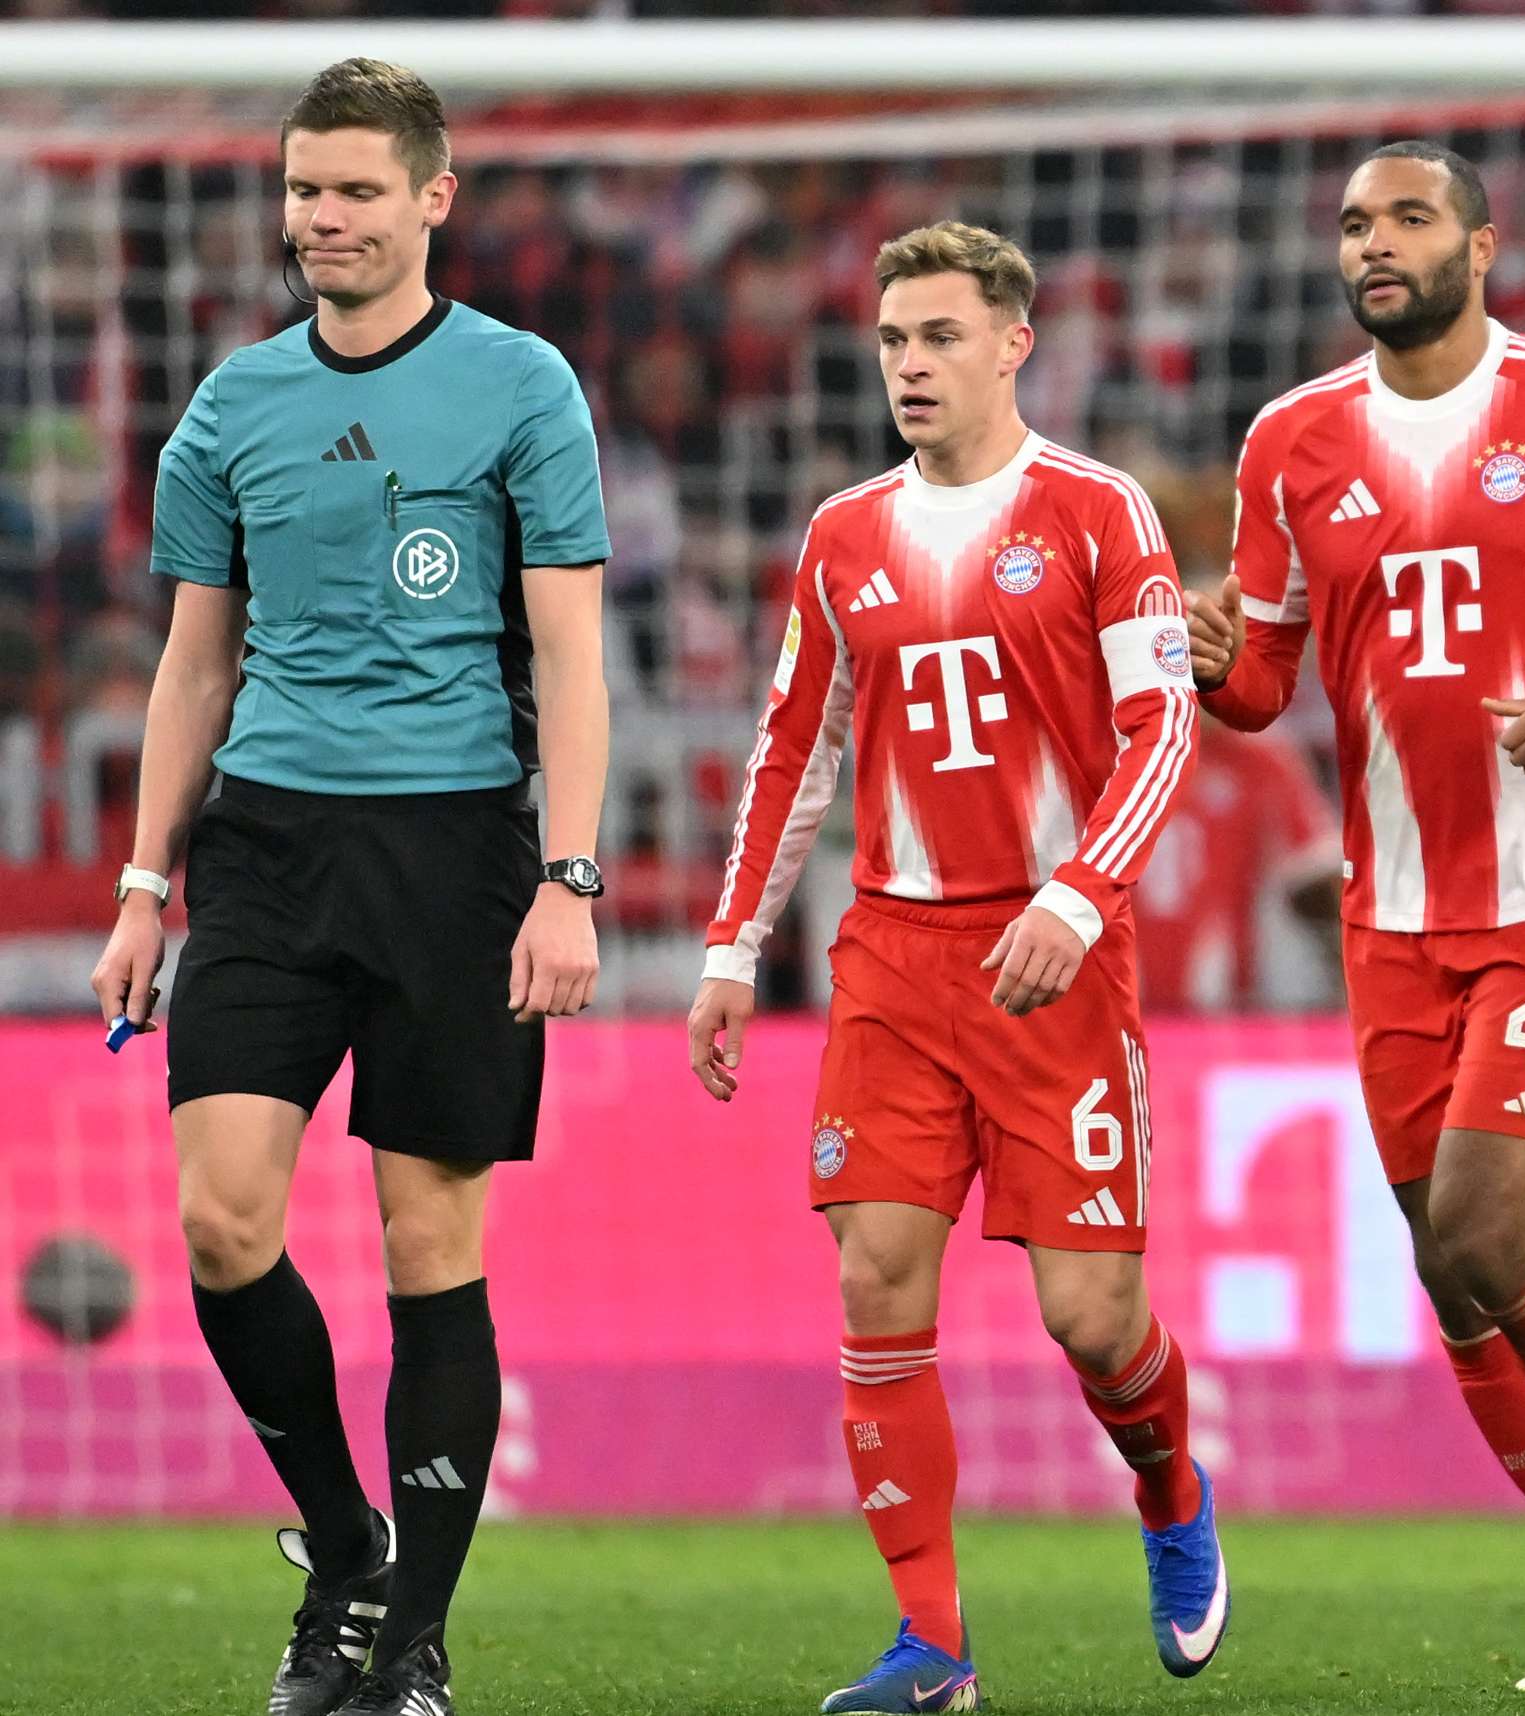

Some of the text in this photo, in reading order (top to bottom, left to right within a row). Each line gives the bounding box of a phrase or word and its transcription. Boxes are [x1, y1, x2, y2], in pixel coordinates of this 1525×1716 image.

[1496, 458, 1525, 475] BAYERN
[1009, 549, 1039, 567] BAYERN
[1381, 545, 1482, 678] T
[899, 635, 1008, 773] T
[1072, 1078, 1123, 1171] 6
